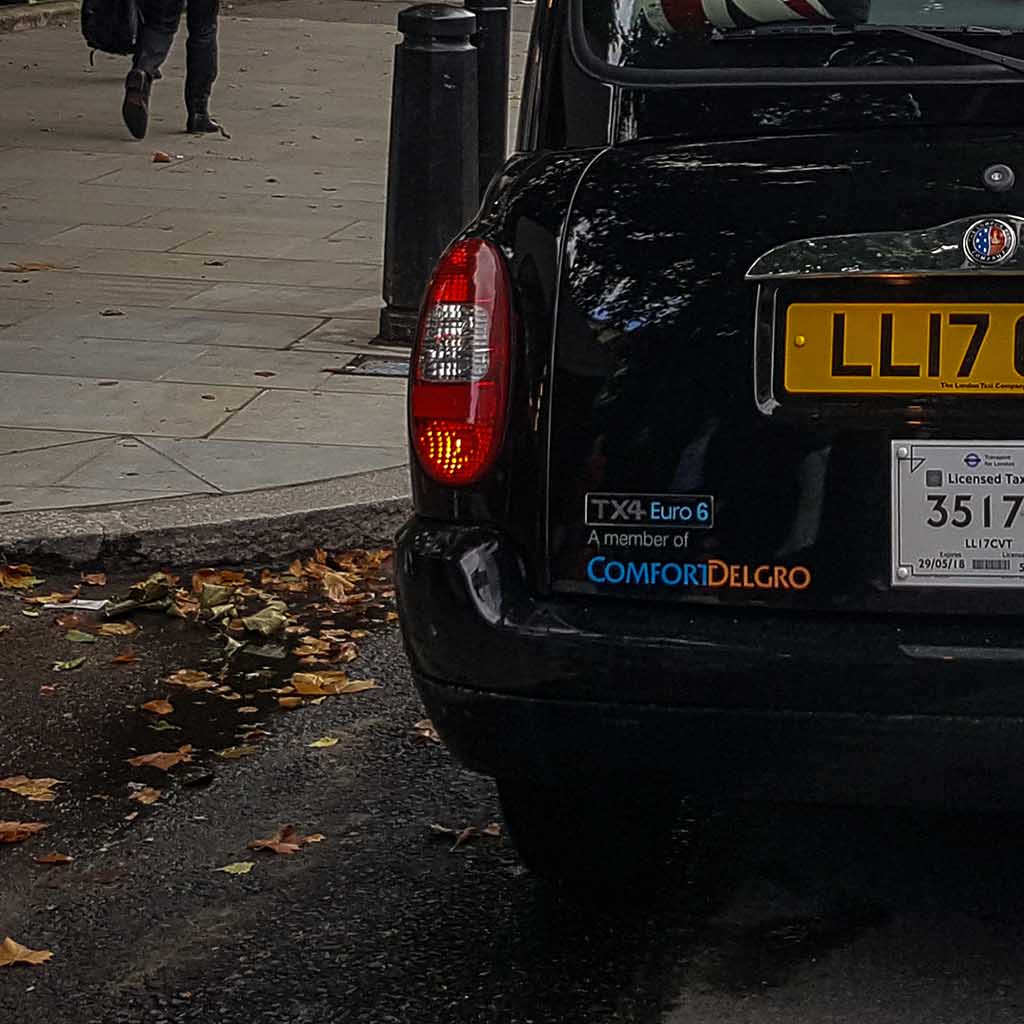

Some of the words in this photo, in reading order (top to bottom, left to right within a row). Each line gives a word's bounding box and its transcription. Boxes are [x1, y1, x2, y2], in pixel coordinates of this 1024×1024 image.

[832, 312, 990, 377] LL17
[948, 473, 1001, 484] Licensed
[591, 499, 646, 520] TX4
[651, 502, 692, 521] Euro
[696, 502, 709, 521] 6
[587, 530, 600, 545] A
[604, 531, 669, 547] member
[673, 532, 689, 548] of
[965, 539, 1013, 549] LL17CVT
[919, 558, 965, 569] 29/05/18
